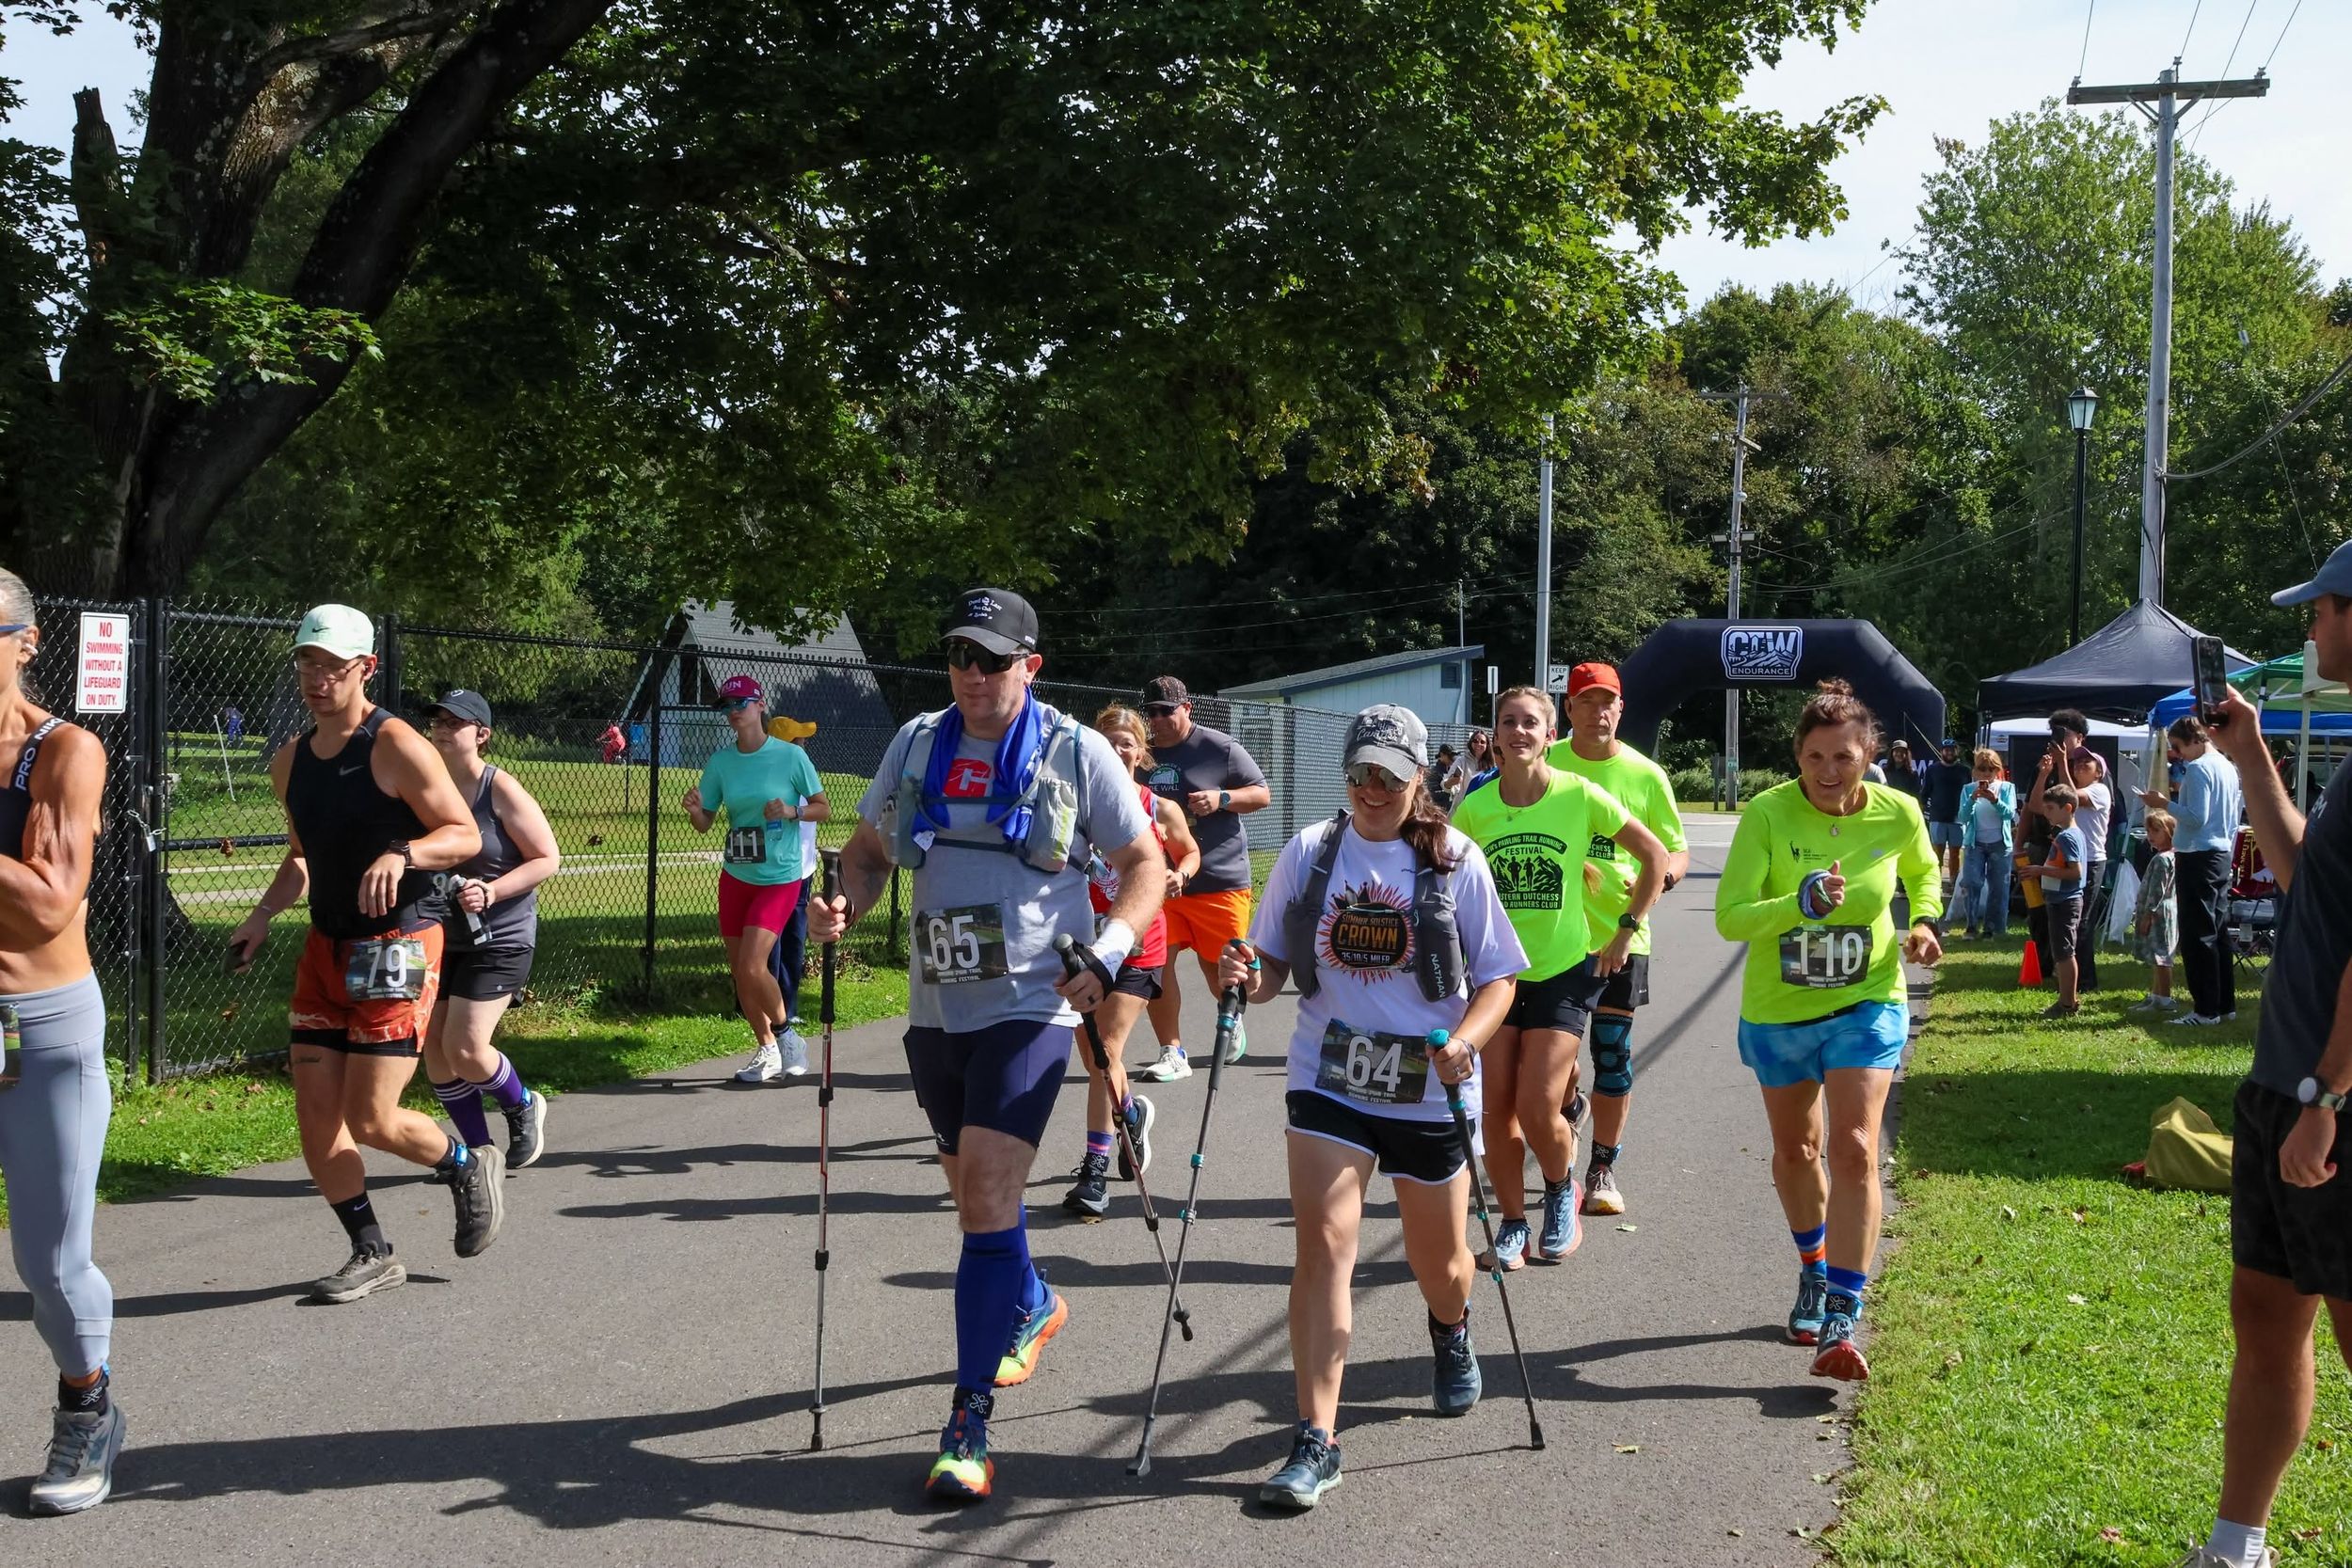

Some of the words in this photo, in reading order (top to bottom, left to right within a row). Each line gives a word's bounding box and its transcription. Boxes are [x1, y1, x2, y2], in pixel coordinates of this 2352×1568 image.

[99, 622, 112, 637] NO
[86, 641, 123, 655] SWIMMING
[85, 659, 116, 672] WITHOUT
[117, 660, 122, 672] A
[84, 676, 121, 689] LIFEGUARD
[723, 680, 741, 690] UN
[86, 694, 96, 705] ON
[98, 694, 118, 705] DUTY.
[15, 747, 36, 790] PRO
[34, 718, 67, 740] NIK
[728, 831, 758, 856] 111
[1498, 835, 1521, 847] PAWLING
[1538, 836, 1563, 850] RUNNING
[1505, 847, 1544, 855] FESTIVAL
[1524, 893, 1559, 901] DUTCHESS
[1509, 900, 1540, 909] RUNNERS
[1342, 913, 1369, 926] SUMMER
[1370, 917, 1399, 927] SOLSTICE
[929, 914, 979, 971] 65
[1338, 924, 1398, 950] CROWN
[1370, 953, 1391, 964] MILER
[1793, 931, 1864, 976] 110
[367, 943, 406, 988] 79
[1430, 954, 1446, 997] NATHAN
[1345, 1036, 1403, 1092] 64
